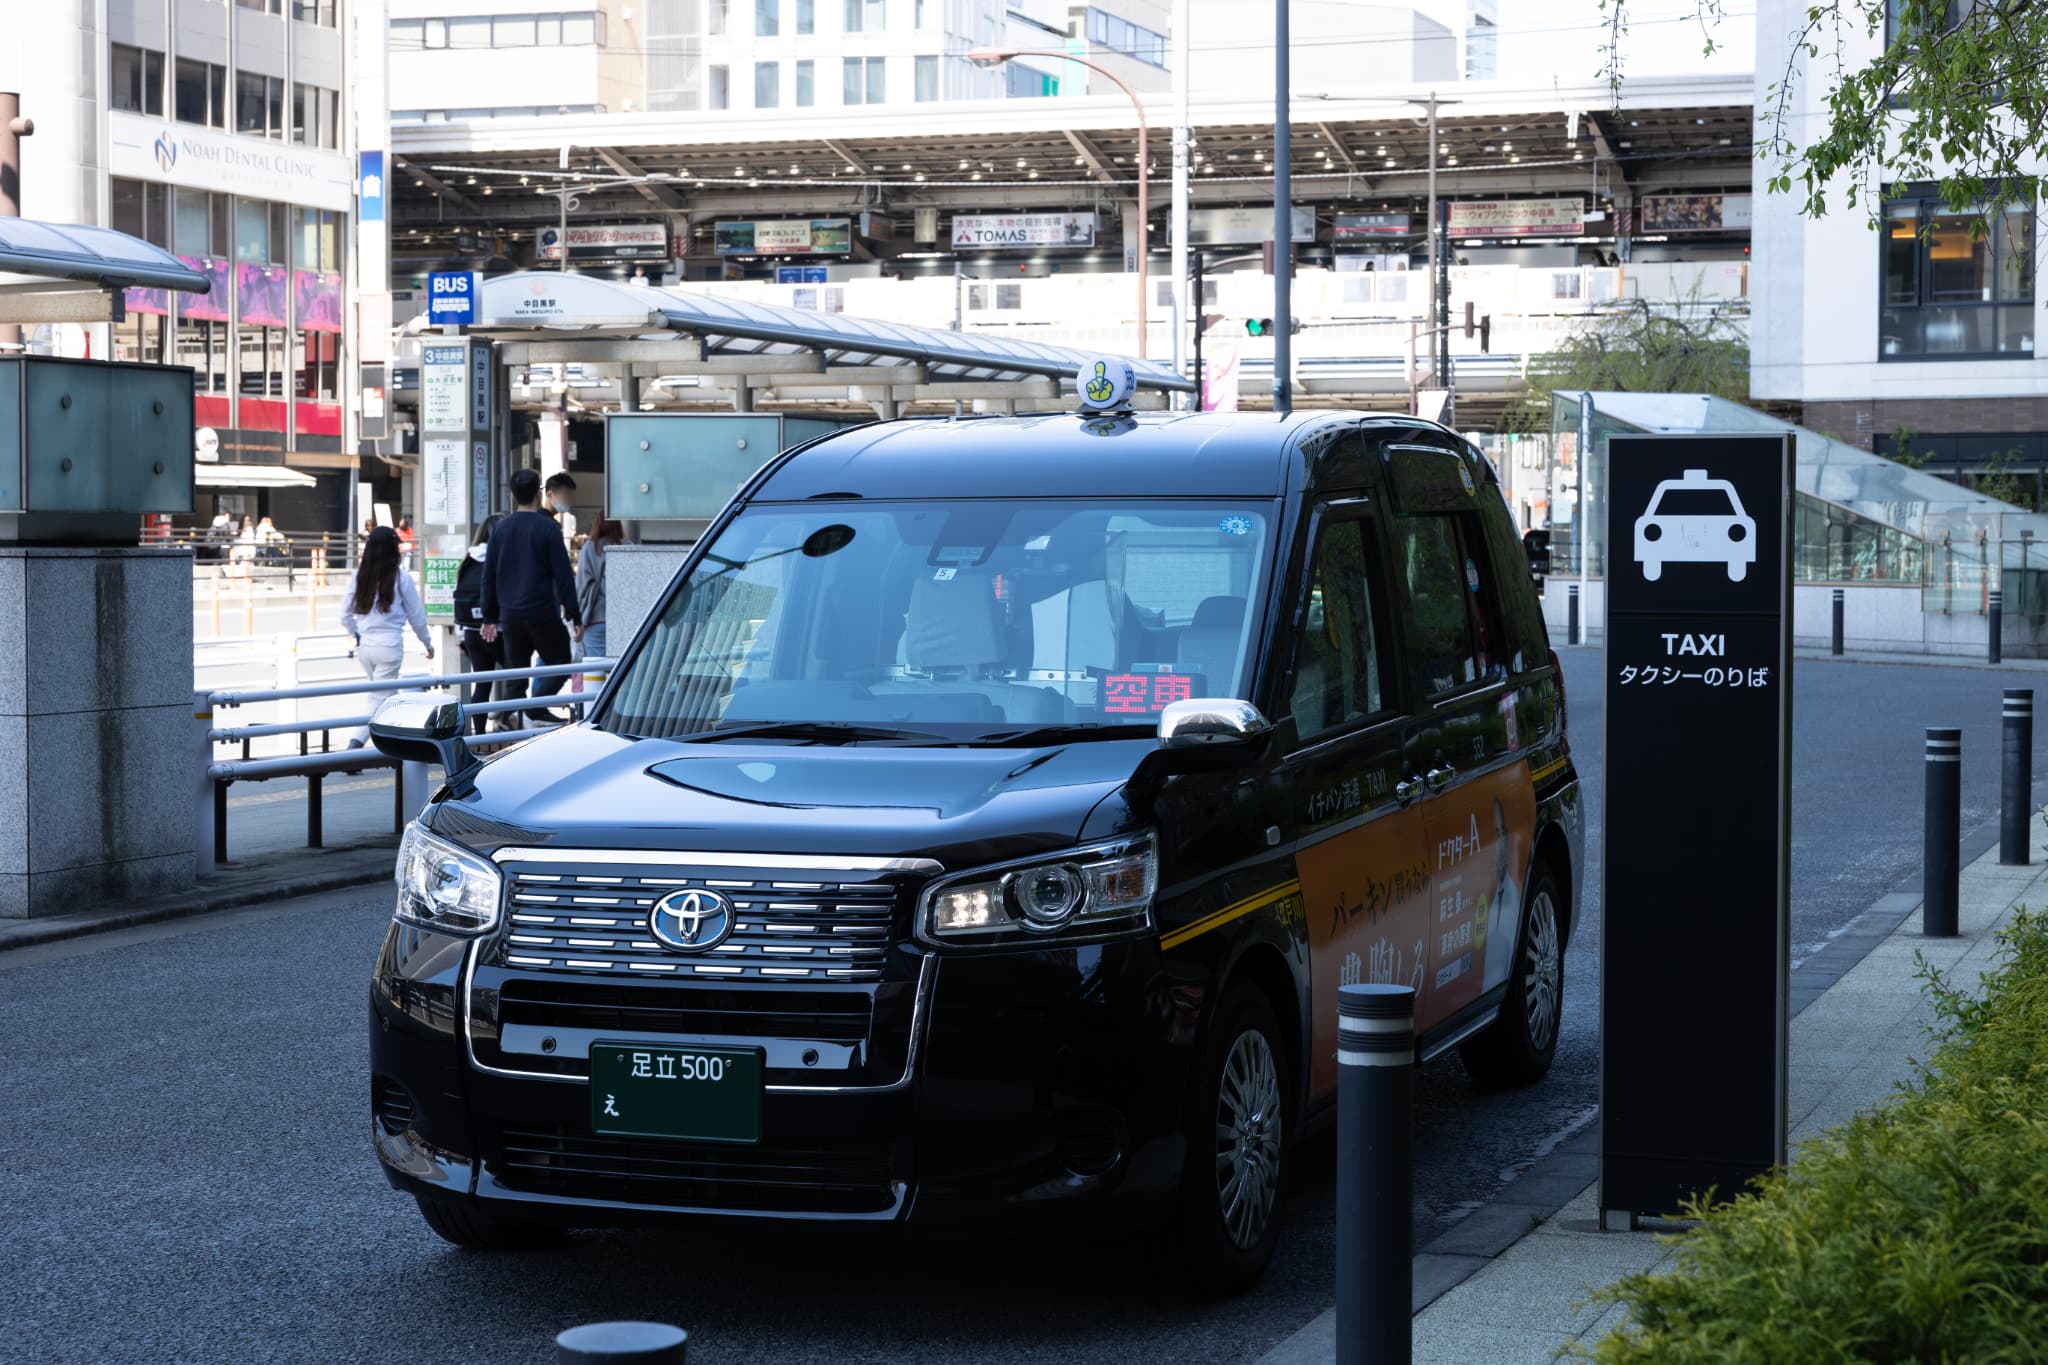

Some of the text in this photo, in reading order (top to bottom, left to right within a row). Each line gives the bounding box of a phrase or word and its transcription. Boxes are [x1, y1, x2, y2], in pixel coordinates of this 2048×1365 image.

[182, 139, 220, 162] NOAH
[225, 146, 271, 171] DENTAL
[274, 155, 318, 178] CLINIC
[975, 229, 1028, 242] TOMAS
[433, 276, 468, 293] BUS
[523, 299, 556, 309] 中目黒駅
[425, 349, 435, 363] 3
[427, 569, 448, 583] 歯科
[1661, 633, 1725, 656] TAXI
[1619, 664, 1769, 687] タクシーのりば
[1105, 673, 1191, 713] 空車
[1366, 768, 1387, 799] TAXI
[1438, 813, 1482, 871] ドクターA
[603, 1094, 620, 1117] え
